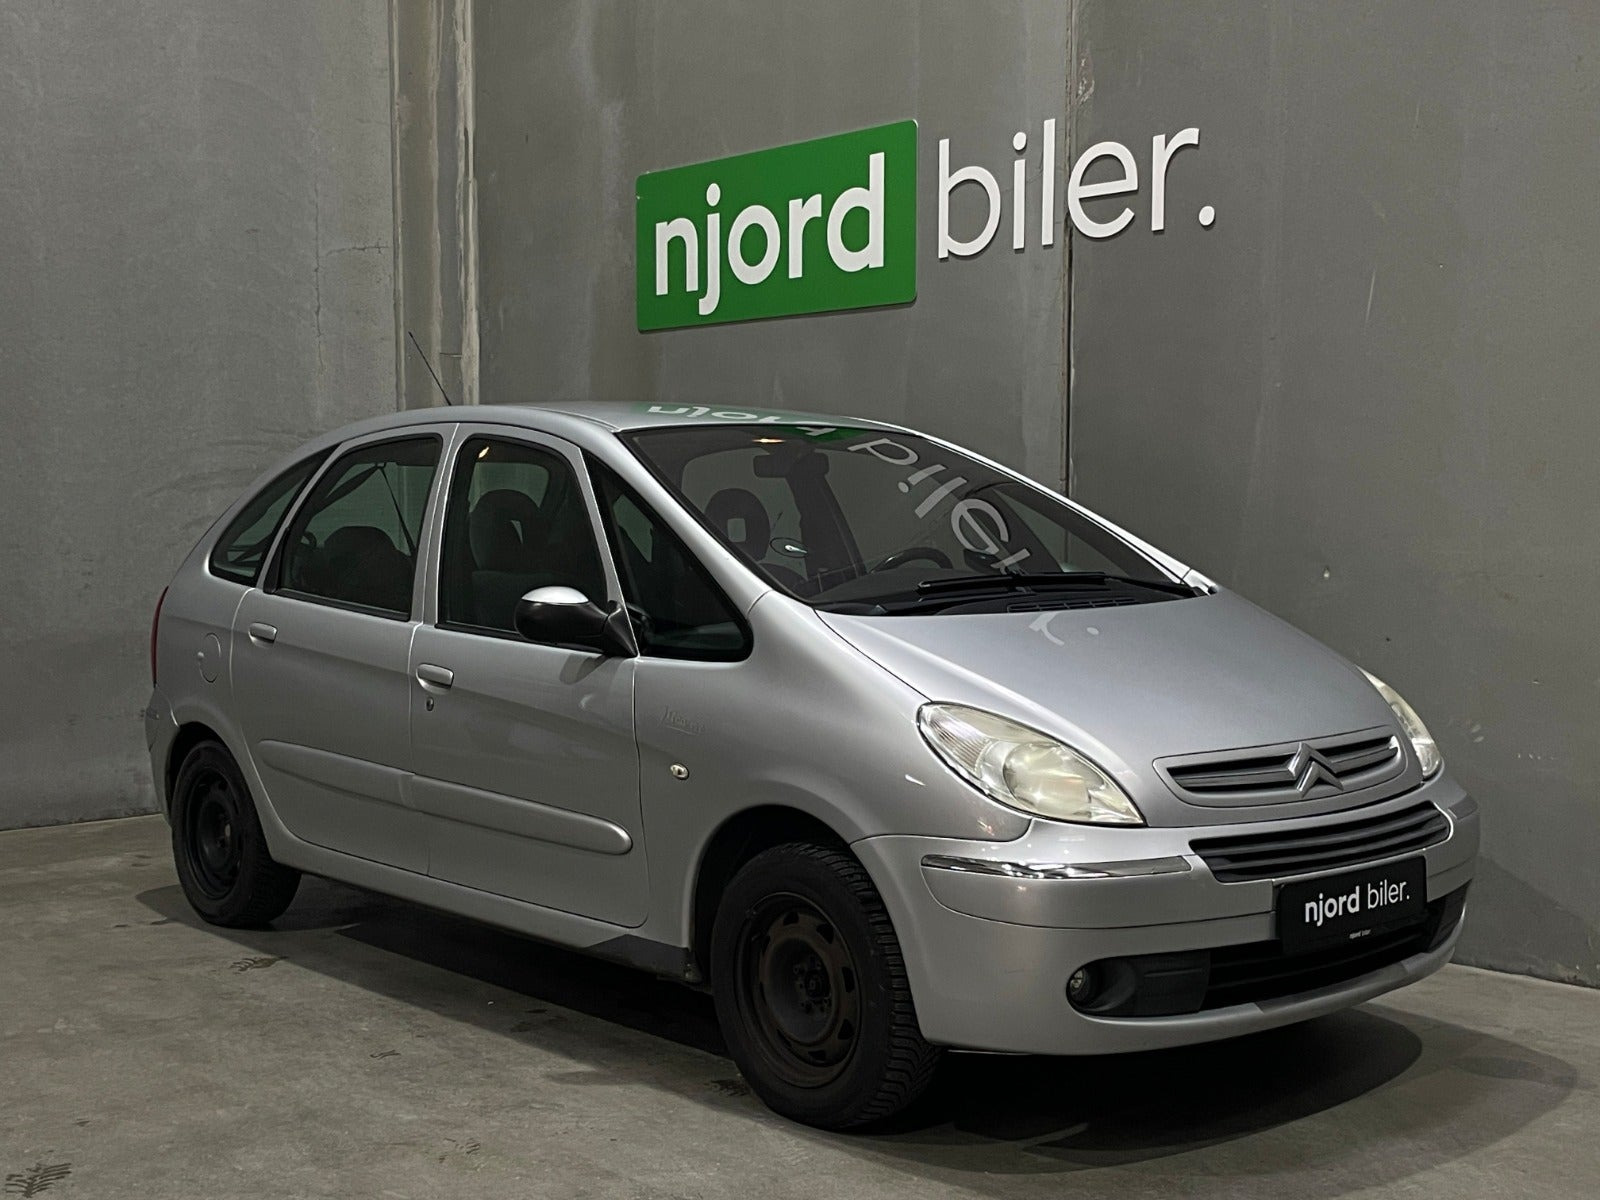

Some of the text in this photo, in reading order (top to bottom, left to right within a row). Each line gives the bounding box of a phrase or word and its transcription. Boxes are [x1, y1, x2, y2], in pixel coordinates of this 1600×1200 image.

[655, 119, 1215, 315] njord biler.
[1305, 879, 1410, 927] njord biler.
